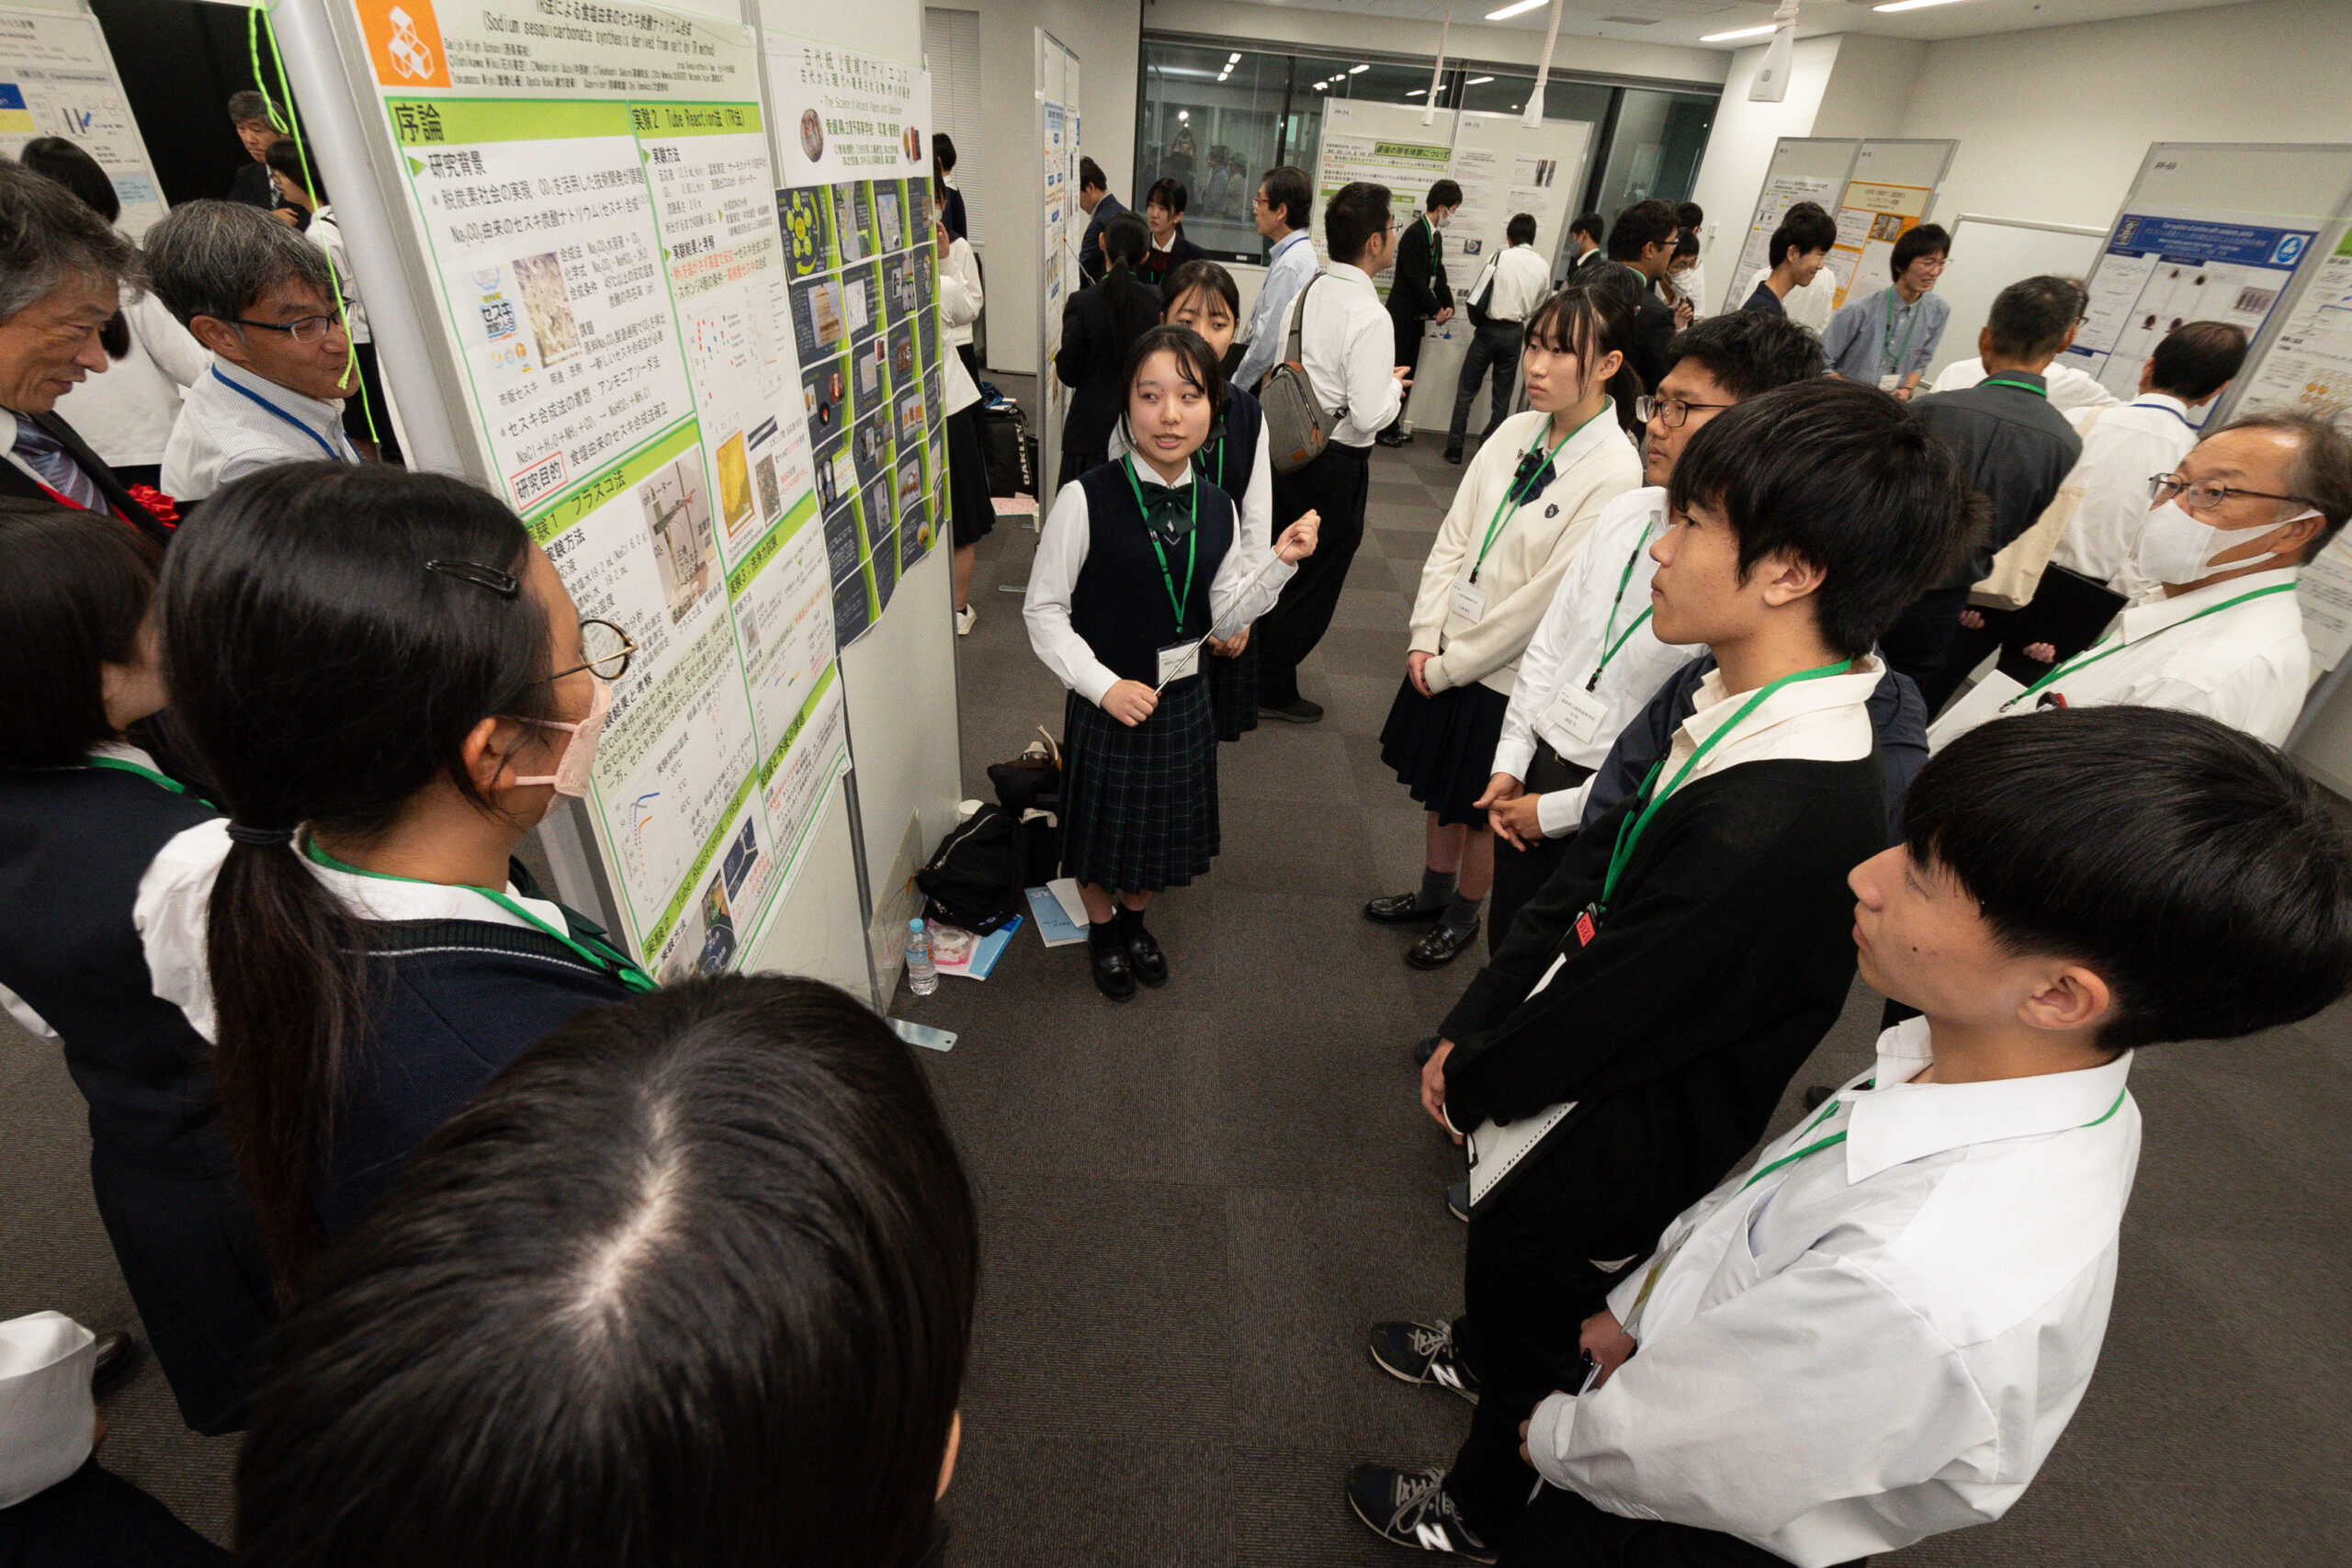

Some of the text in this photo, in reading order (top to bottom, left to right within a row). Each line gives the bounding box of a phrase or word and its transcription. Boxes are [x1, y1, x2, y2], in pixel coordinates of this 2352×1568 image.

[394, 103, 444, 142] 序論
[427, 150, 487, 179] 研究背景
[481, 301, 512, 322] セスキ
[1015, 423, 1030, 485] OAKLEY
[514, 460, 562, 500] 研究目的
[570, 469, 627, 517] フラスコ法
